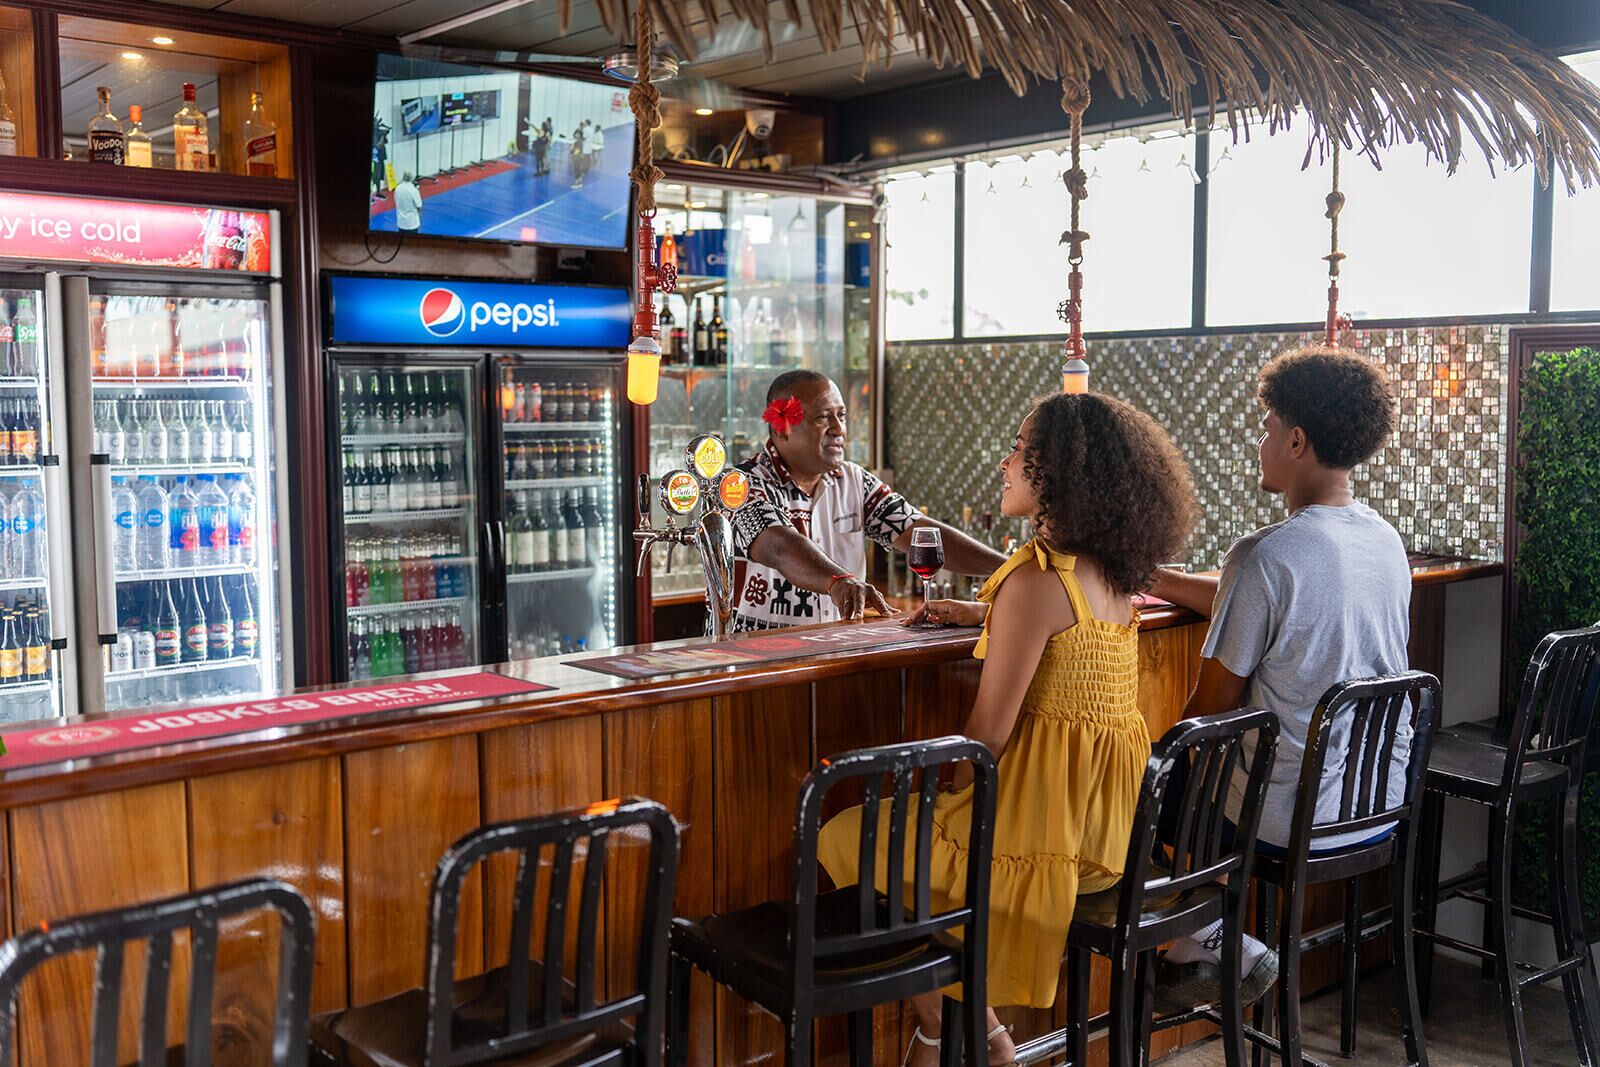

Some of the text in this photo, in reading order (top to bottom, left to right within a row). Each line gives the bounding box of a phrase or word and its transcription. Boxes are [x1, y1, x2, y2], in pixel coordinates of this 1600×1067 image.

[30, 212, 72, 239] ice
[80, 218, 141, 243] cold
[470, 298, 556, 333] pepsi
[129, 683, 452, 733] JOSKES BREW
